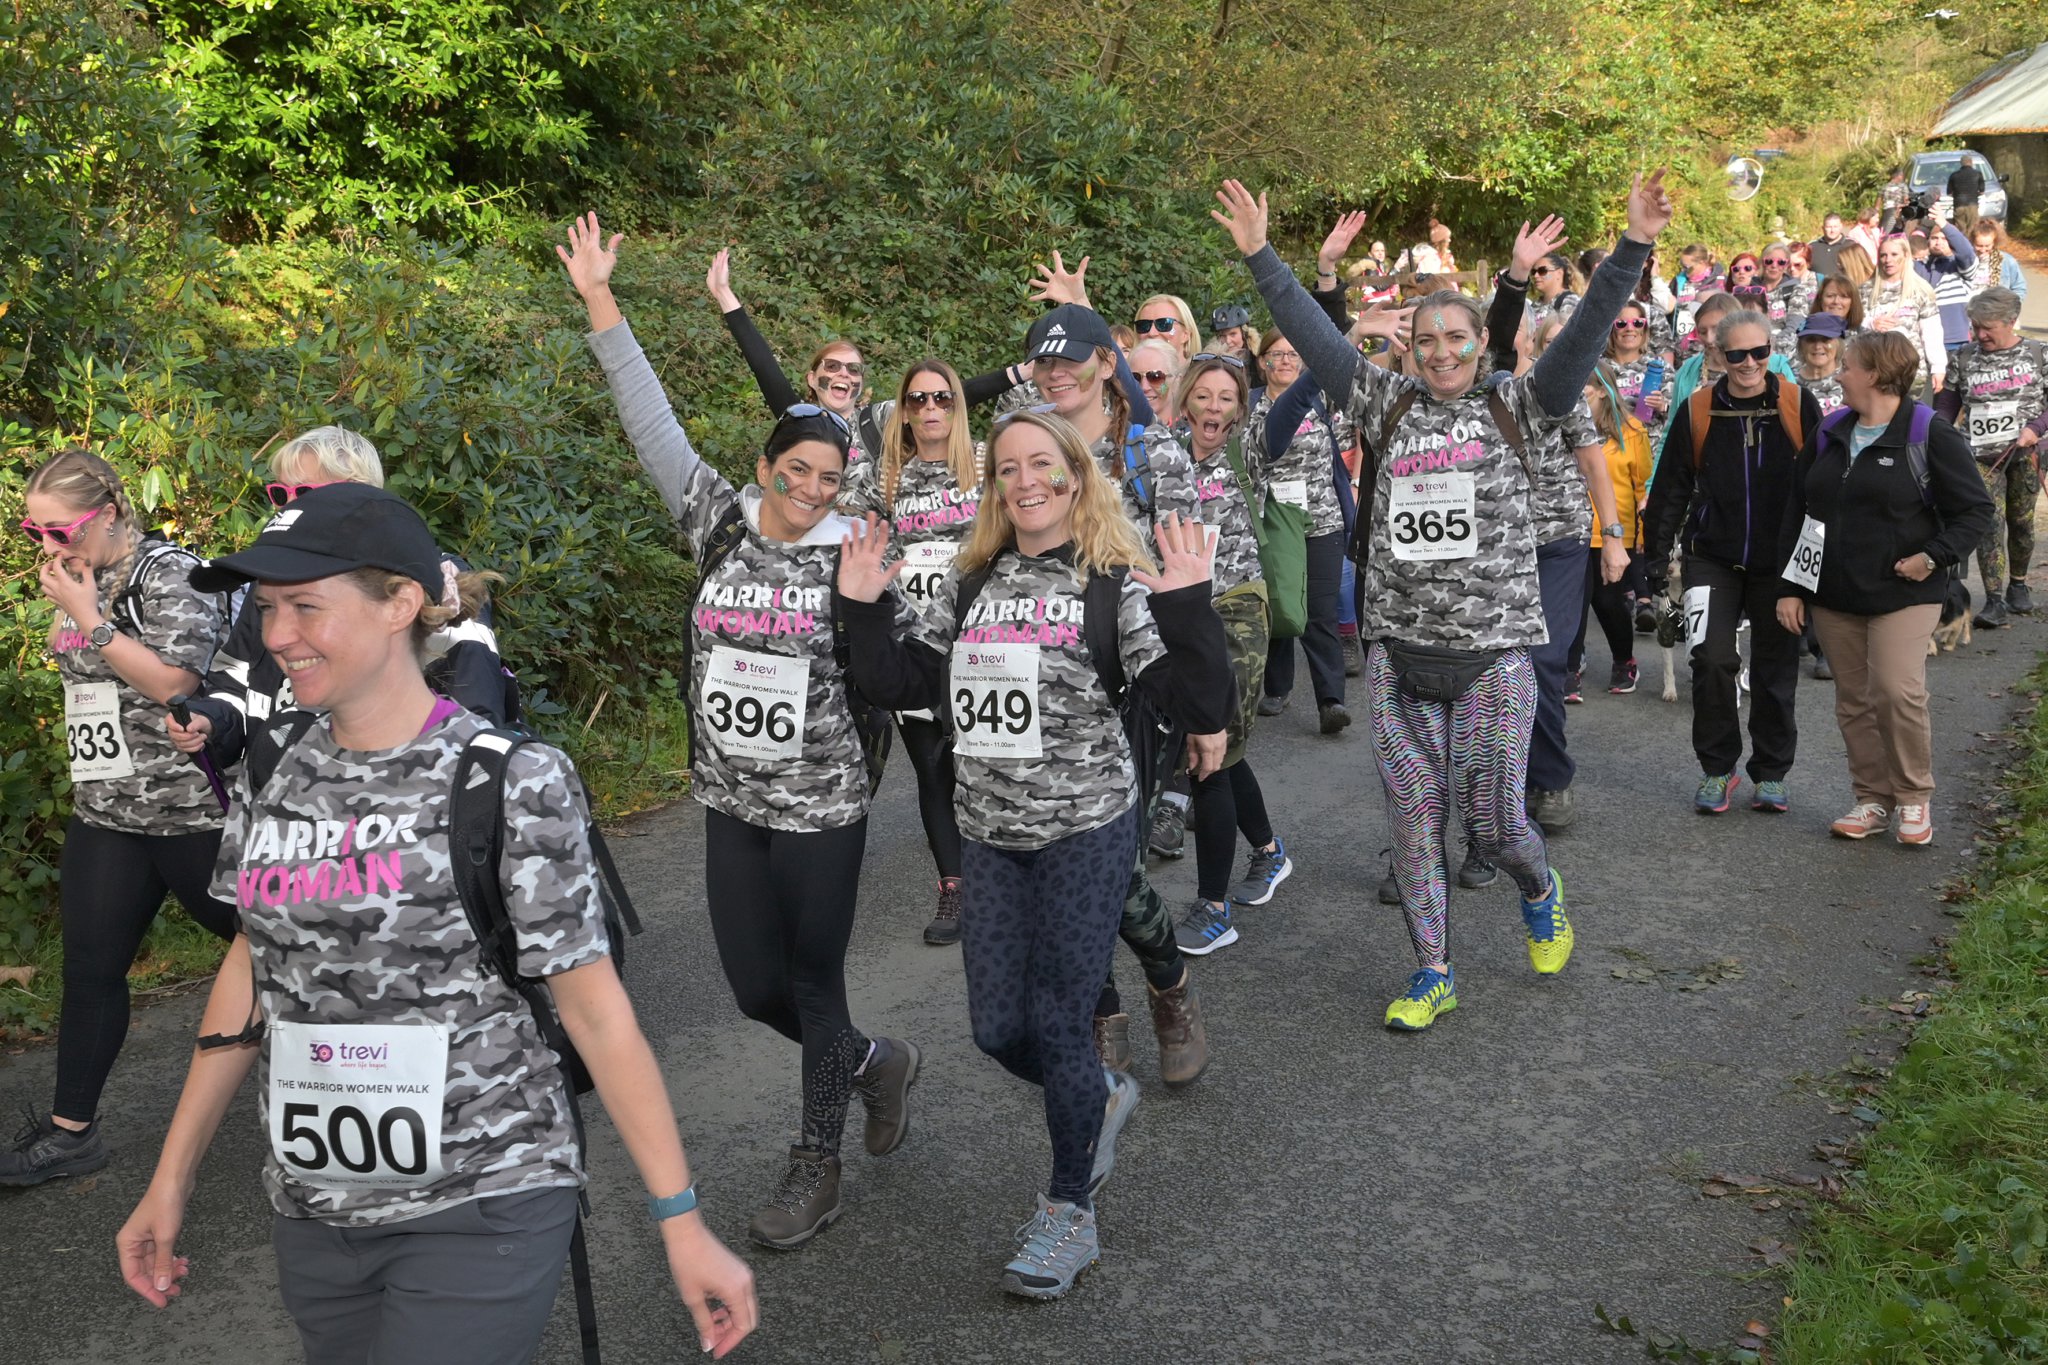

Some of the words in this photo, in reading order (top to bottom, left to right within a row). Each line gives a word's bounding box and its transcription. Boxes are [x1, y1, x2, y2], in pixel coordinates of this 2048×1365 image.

[1967, 363, 2032, 386] WARRIOR
[1972, 374, 2032, 395] WOMAN
[1972, 416, 2015, 436] 362
[1388, 420, 1485, 461] WARRIOR
[1391, 440, 1487, 477] WOMAN
[1426, 481, 1448, 491] trevi
[895, 486, 979, 517] WARRIOR
[897, 501, 977, 533] WOMAN
[1393, 509, 1471, 544] 365
[934, 548, 953, 556] trevi
[1793, 543, 1822, 577] 498
[698, 580, 823, 611] WARRIOR
[906, 572, 945, 600] 40
[698, 608, 815, 635] WOMAN
[961, 597, 1085, 629] WARRIOR
[959, 622, 1078, 646] WOMAN
[733, 660, 747, 673] 30
[750, 661, 776, 675] trevi
[967, 653, 978, 665] 30
[980, 652, 1006, 664] trevi
[710, 677, 722, 685] THE
[723, 679, 750, 691] WARRIOR
[752, 685, 778, 694] WOMEN
[706, 690, 796, 743] 396
[955, 688, 1032, 735] 349
[67, 721, 120, 762] 333
[720, 740, 735, 748] Wave
[753, 745, 778, 753] 11.00am
[236, 850, 402, 909] WOMAN
[309, 1043, 333, 1063] 30
[339, 1042, 388, 1060] trevi
[277, 1079, 295, 1089] THE
[297, 1081, 344, 1093] WARRIOR
[346, 1084, 393, 1094] WOMEN
[396, 1084, 430, 1094] WALK
[282, 1102, 427, 1175] 500
